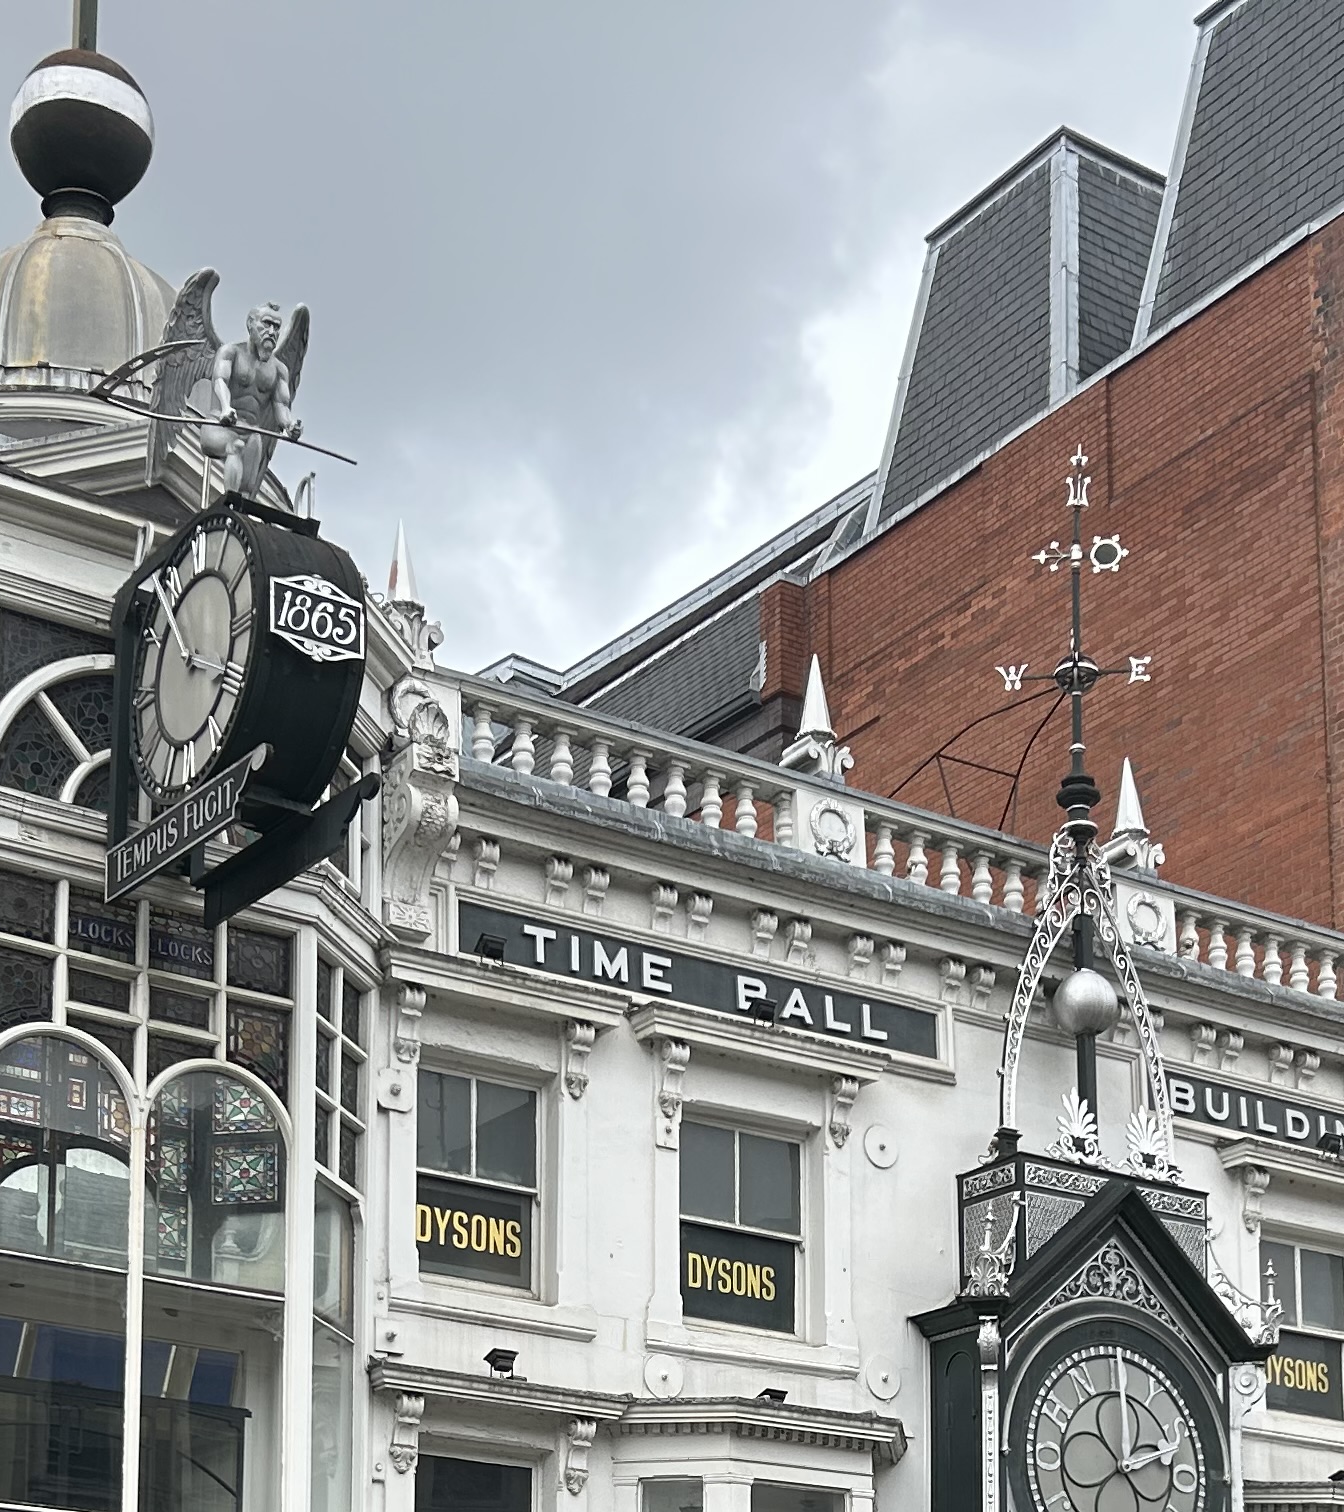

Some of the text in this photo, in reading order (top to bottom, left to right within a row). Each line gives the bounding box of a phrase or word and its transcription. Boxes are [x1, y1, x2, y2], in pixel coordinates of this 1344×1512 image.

[277, 589, 358, 647] 1865
[1128, 656, 1151, 684] E
[114, 778, 237, 884] TEMPUS FUGIT
[150, 937, 214, 966] LOCKS
[523, 924, 889, 1041] TIME BALL
[416, 1203, 522, 1258] DYSONS
[687, 1251, 776, 1302] DYSONS
